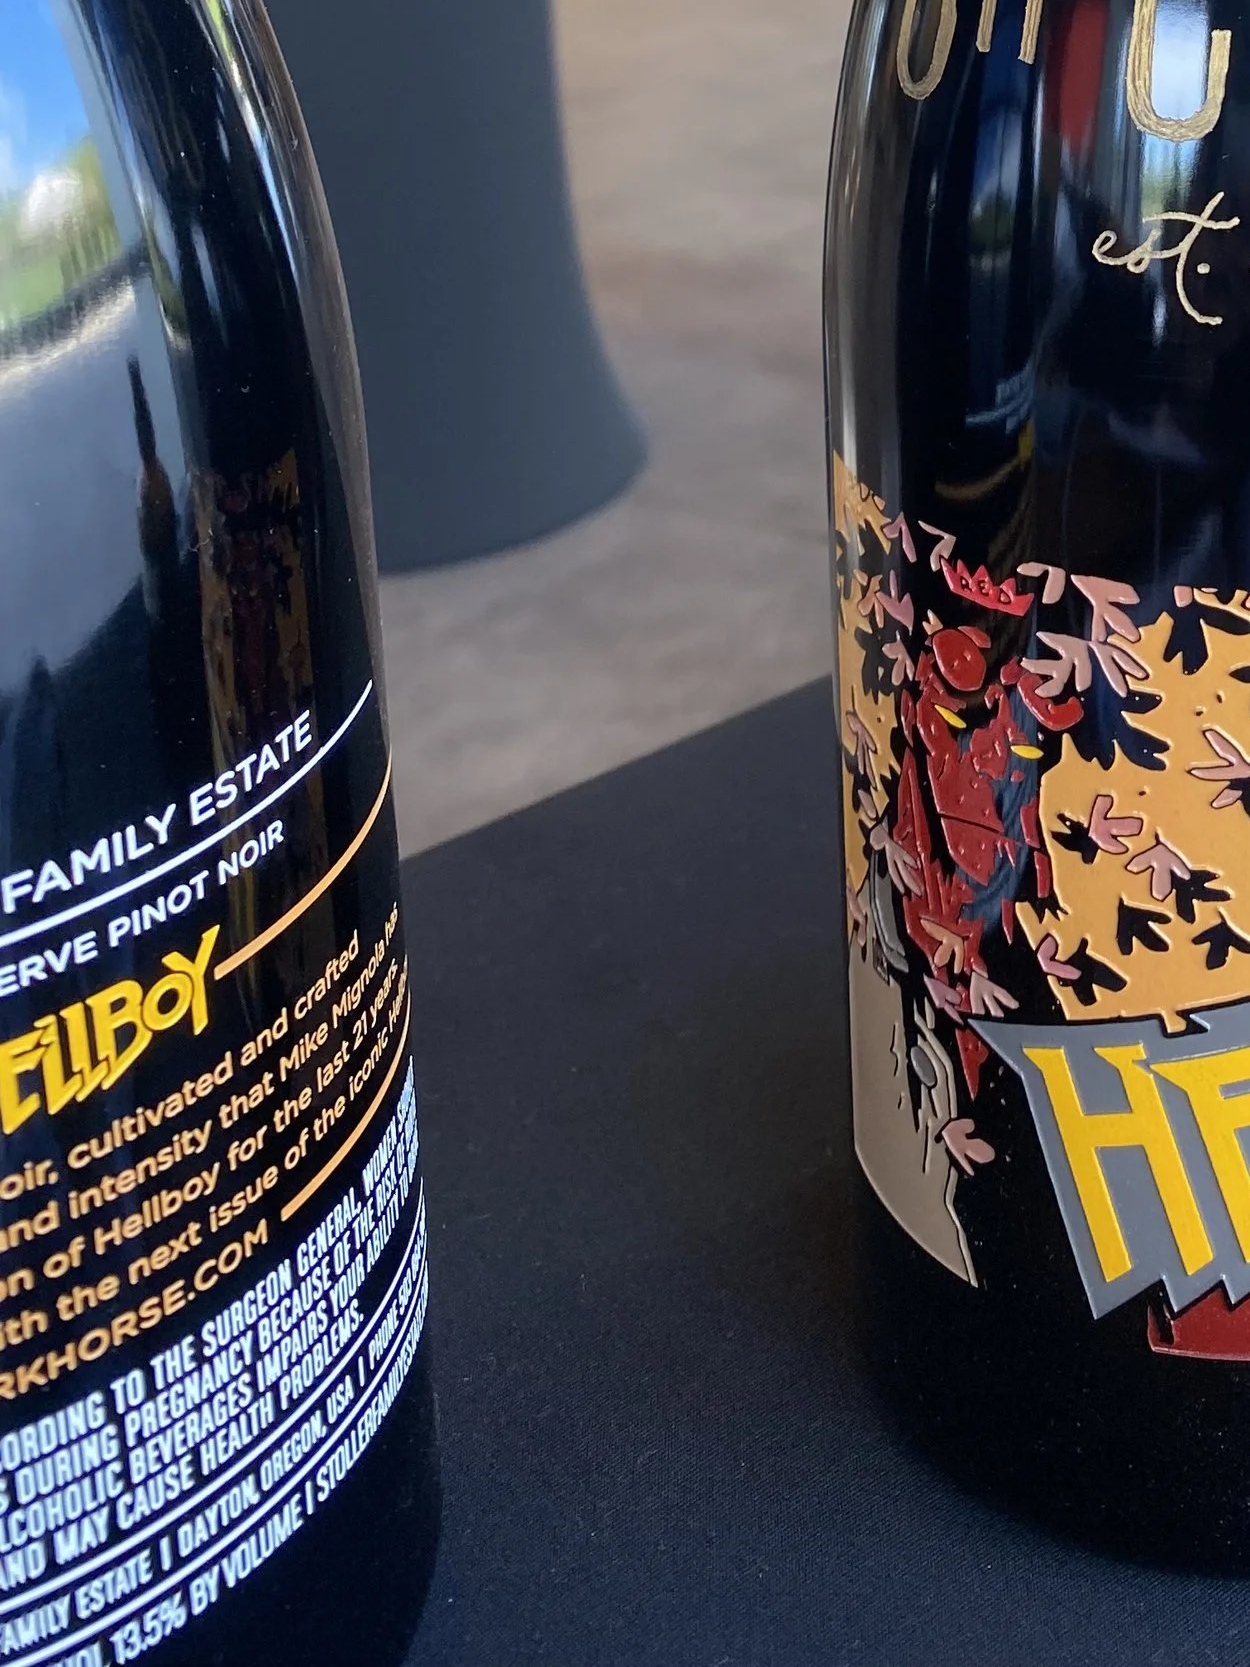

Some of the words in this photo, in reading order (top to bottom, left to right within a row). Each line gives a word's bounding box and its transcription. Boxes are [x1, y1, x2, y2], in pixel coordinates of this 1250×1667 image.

[1092, 192, 1240, 324] est.
[960, 575, 1012, 605] RED
[1, 803, 177, 914] FAMILY
[189, 709, 312, 826] ESTATE
[108, 870, 209, 947] PINOT
[218, 820, 284, 885] NOIR
[43, 1235, 85, 1278] of
[94, 1162, 220, 1255] Hellboy
[227, 1125, 267, 1171] for
[273, 1087, 312, 1133] the
[317, 1040, 350, 1093] last
[353, 1011, 367, 1050] 21
[370, 958, 398, 1028] years
[56, 1274, 120, 1321] the
[128, 1221, 202, 1285] next
[209, 1165, 279, 1233] issue
[284, 1127, 309, 1170] of
[313, 1095, 346, 1141] the
[349, 1027, 389, 1101] iconic
[67, 1051, 234, 1170] cultivated
[240, 1007, 289, 1066] and
[294, 929, 359, 1019] crafted
[68, 1119, 213, 1219] intensity
[219, 1071, 275, 1129] that
[279, 1022, 329, 1082] Mike
[332, 939, 385, 1028] Mignola
[0, 1391, 106, 1473] ORDING
[110, 1368, 146, 1414] TO
[150, 1335, 197, 1390] THE
[201, 1258, 292, 1357] SURGEON
[297, 1187, 362, 1277] GENERAL,
[362, 1115, 397, 1197] WOMEN
[15, 1423, 121, 1505] DURING
[124, 1330, 253, 1448] PREGNANCY
[257, 1256, 332, 1353] BECAUSE
[333, 1230, 351, 1276] OF
[352, 1197, 375, 1250] THE
[376, 1155, 397, 1217] RISK
[129, 1372, 252, 1484] BEVERAGES
[256, 1299, 328, 1393] IMPAIRS
[329, 1252, 365, 1317] YOUR
[366, 1188, 399, 1273] ABILITY
[0, 1592, 71, 1655] AMILY
[74, 1547, 153, 1619] ESTATE
[177, 1473, 260, 1558] DAYTON,
[326, 1374, 354, 1424] USA
[368, 1298, 399, 1371] PHONE
[53, 1506, 109, 1565] MAY
[116, 1454, 196, 1530] CAUSE
[200, 1391, 274, 1476] HEALTH
[279, 1298, 364, 1411] PROBLEMS.
[109, 1589, 187, 1665] 13.5%
[189, 1564, 220, 1615] BY
[221, 1493, 305, 1588] VOLUME
